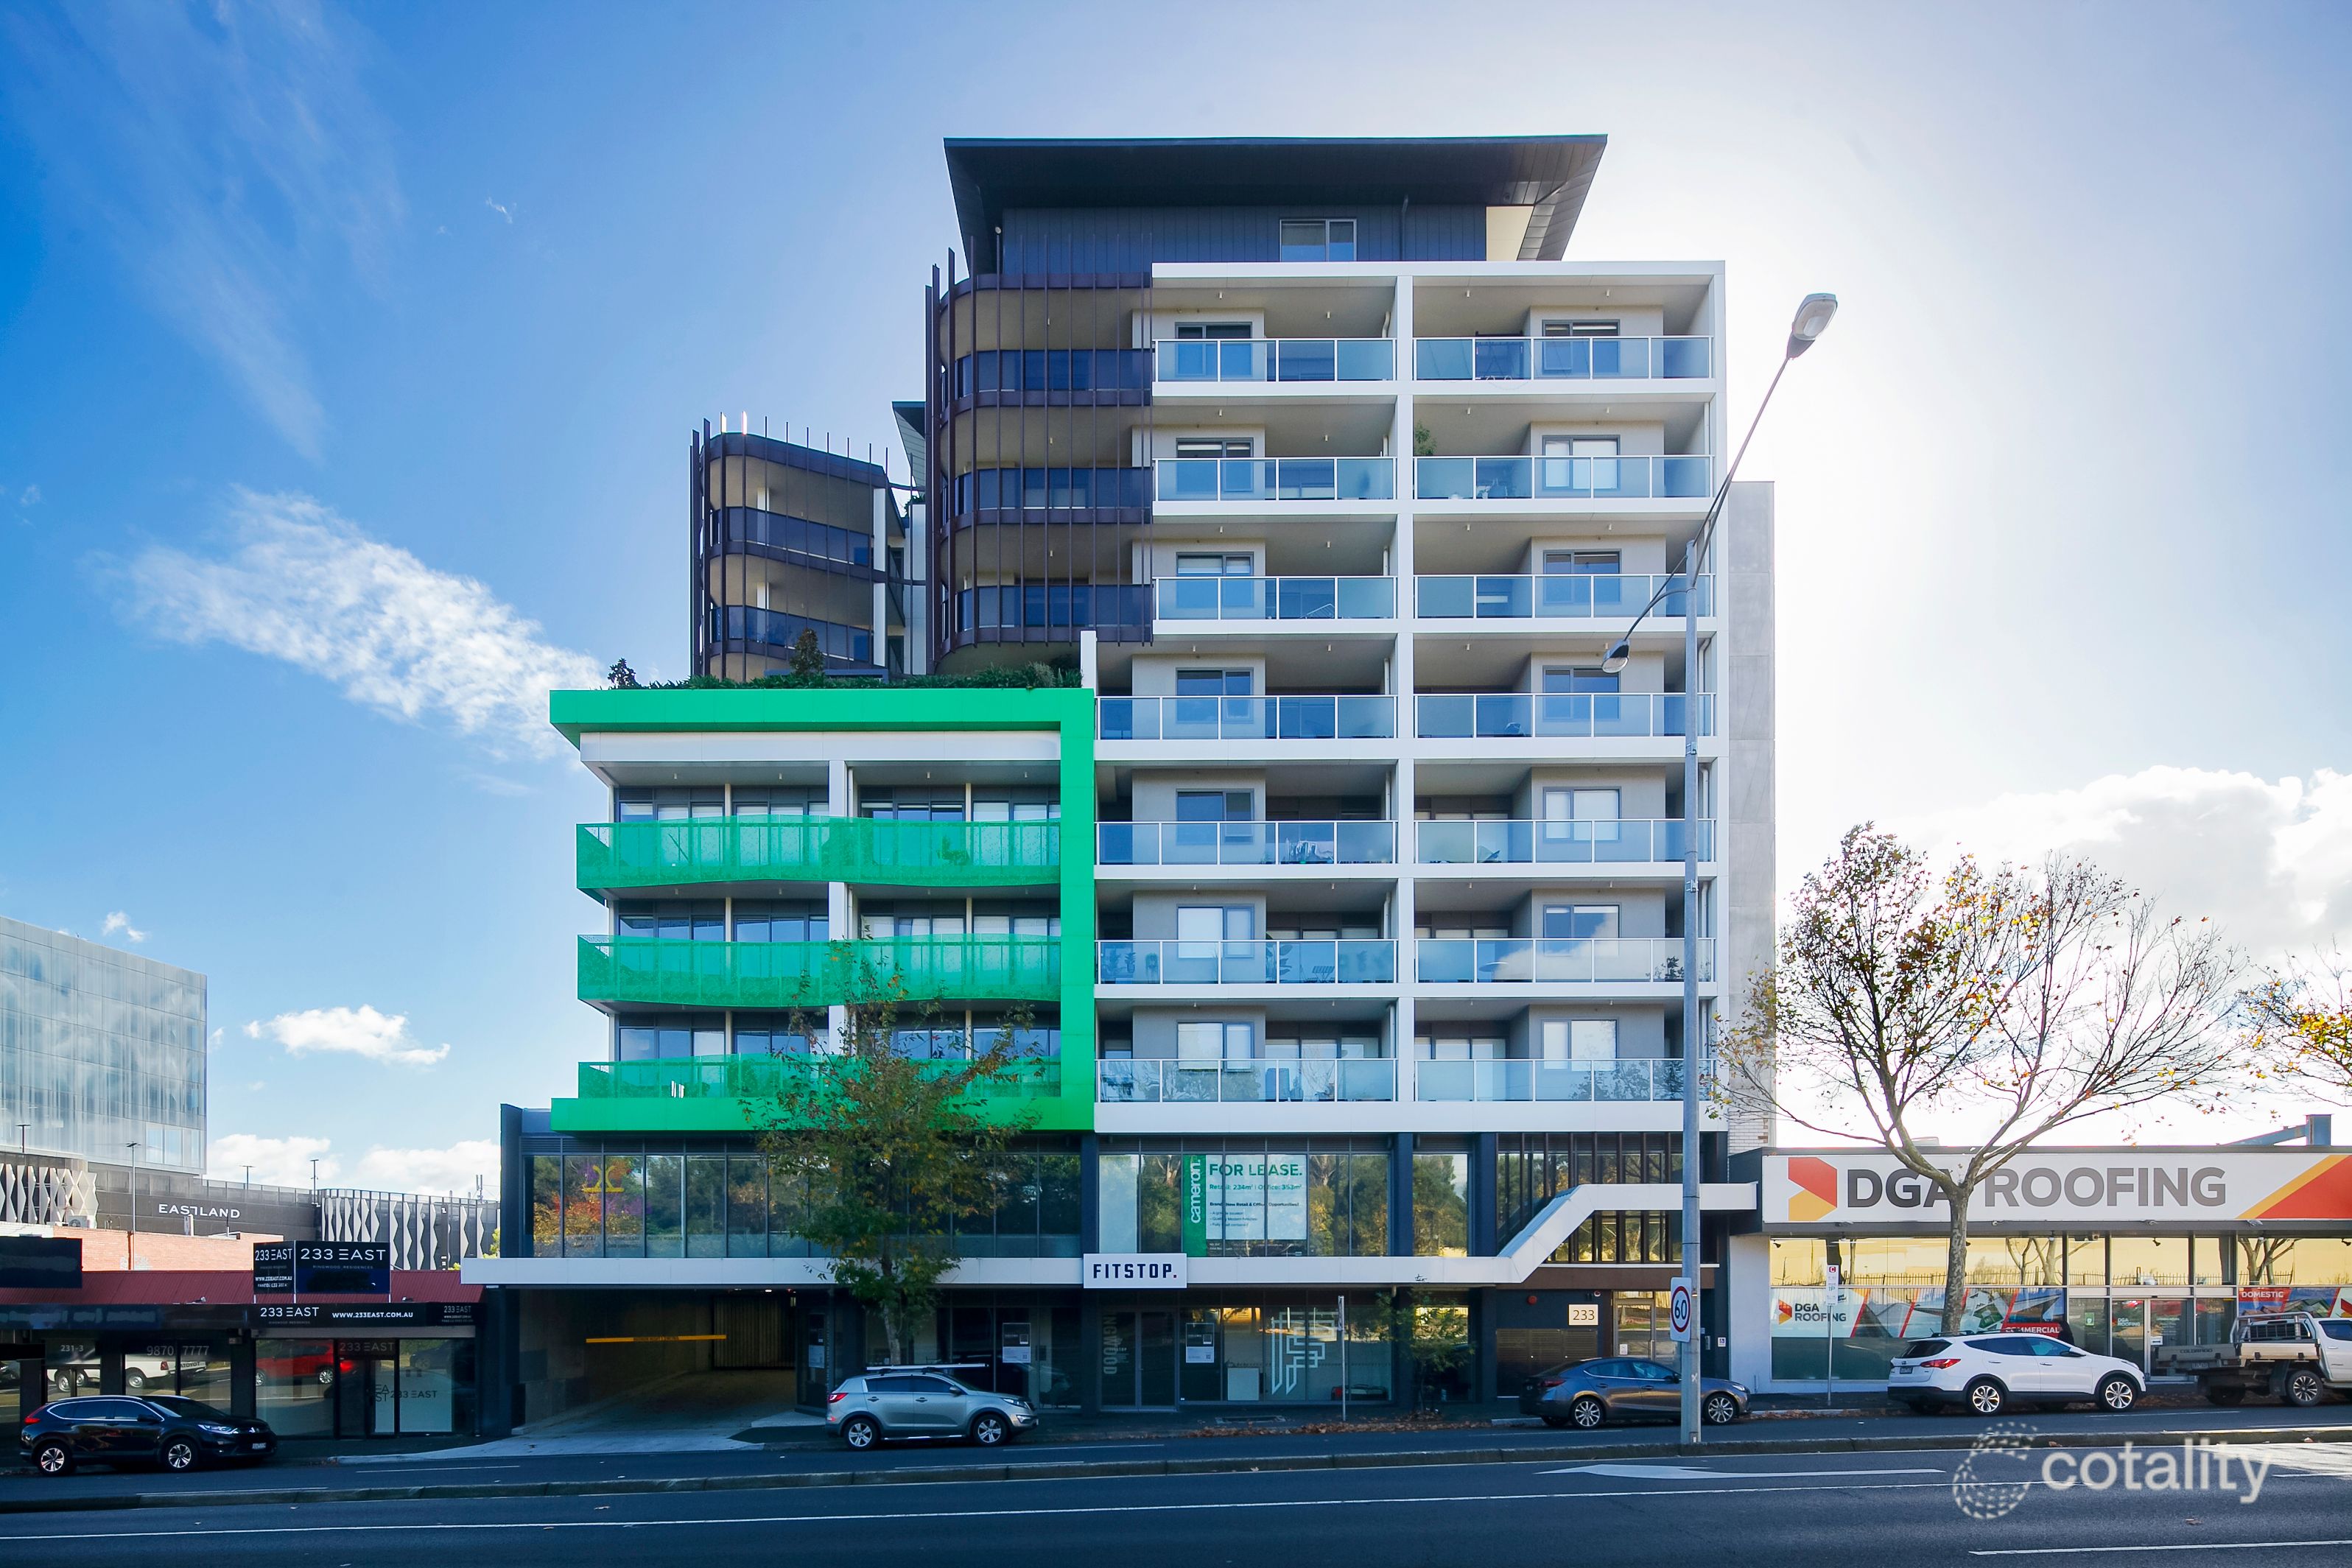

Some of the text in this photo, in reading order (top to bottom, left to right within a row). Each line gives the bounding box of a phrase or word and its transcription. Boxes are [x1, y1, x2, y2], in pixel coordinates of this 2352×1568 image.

[1210, 1164, 1302, 1176] FOR LEASE.
[1190, 1159, 1201, 1223] cameron.
[1985, 1167, 2226, 1208] ROOFING
[158, 1203, 240, 1218] EASTLAND
[255, 1248, 292, 1261] 233 EAST
[301, 1248, 386, 1261] 233 EAST
[1093, 1263, 1177, 1279] FITSTOP.
[260, 1307, 320, 1317] 233 EAST
[443, 1305, 471, 1313] 233 EAST
[1674, 1299, 1688, 1320] 60
[1795, 1303, 1819, 1312] DGA
[1573, 1309, 1595, 1321] 233
[1795, 1312, 1847, 1322] ROOFING
[147, 1346, 210, 1356] 9870 7777
[340, 1342, 395, 1351] 233 EAST
[390, 1390, 438, 1399] 23 EAST
